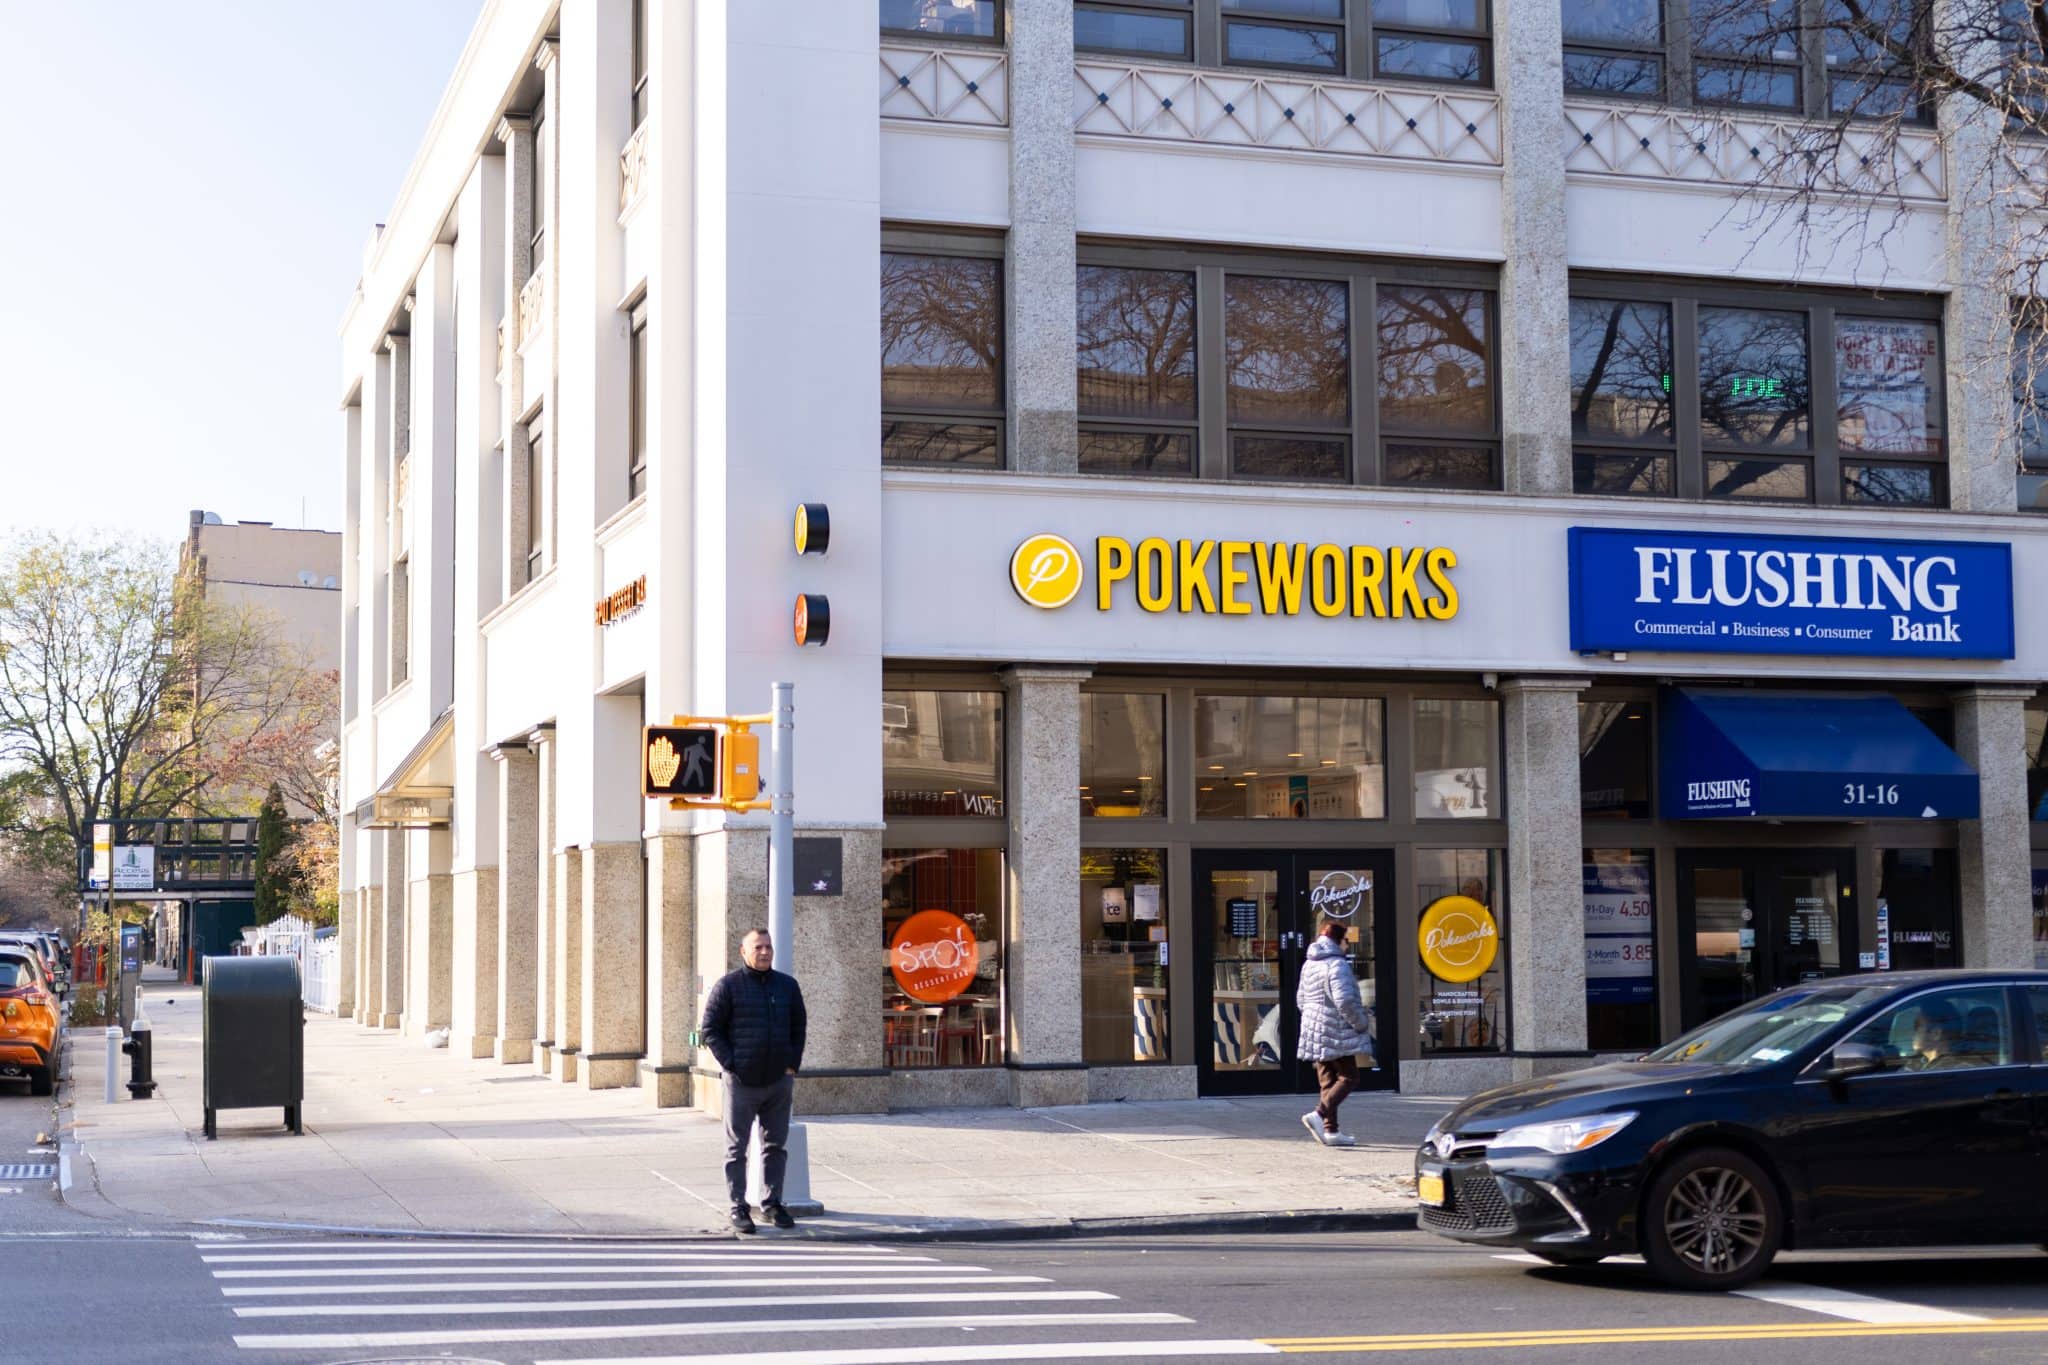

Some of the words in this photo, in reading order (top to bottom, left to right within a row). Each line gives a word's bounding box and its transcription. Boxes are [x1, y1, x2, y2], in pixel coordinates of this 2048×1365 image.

[1096, 535, 1459, 621] POKEWORKS
[1633, 547, 1961, 613] FLUSHING
[1634, 618, 1717, 635] Commercial
[1732, 622, 1790, 638] Business
[1805, 624, 1873, 640] Consumer
[1890, 614, 1962, 643] Bank
[1687, 778, 1751, 801] FLUSHING
[1843, 783, 1899, 805] 31-16
[1311, 876, 1373, 911] Pokeworks
[1620, 900, 1651, 917] 4.50
[127, 936, 136, 949] P
[1426, 921, 1496, 957] Pokeworks
[914, 974, 950, 991] DESSERT
